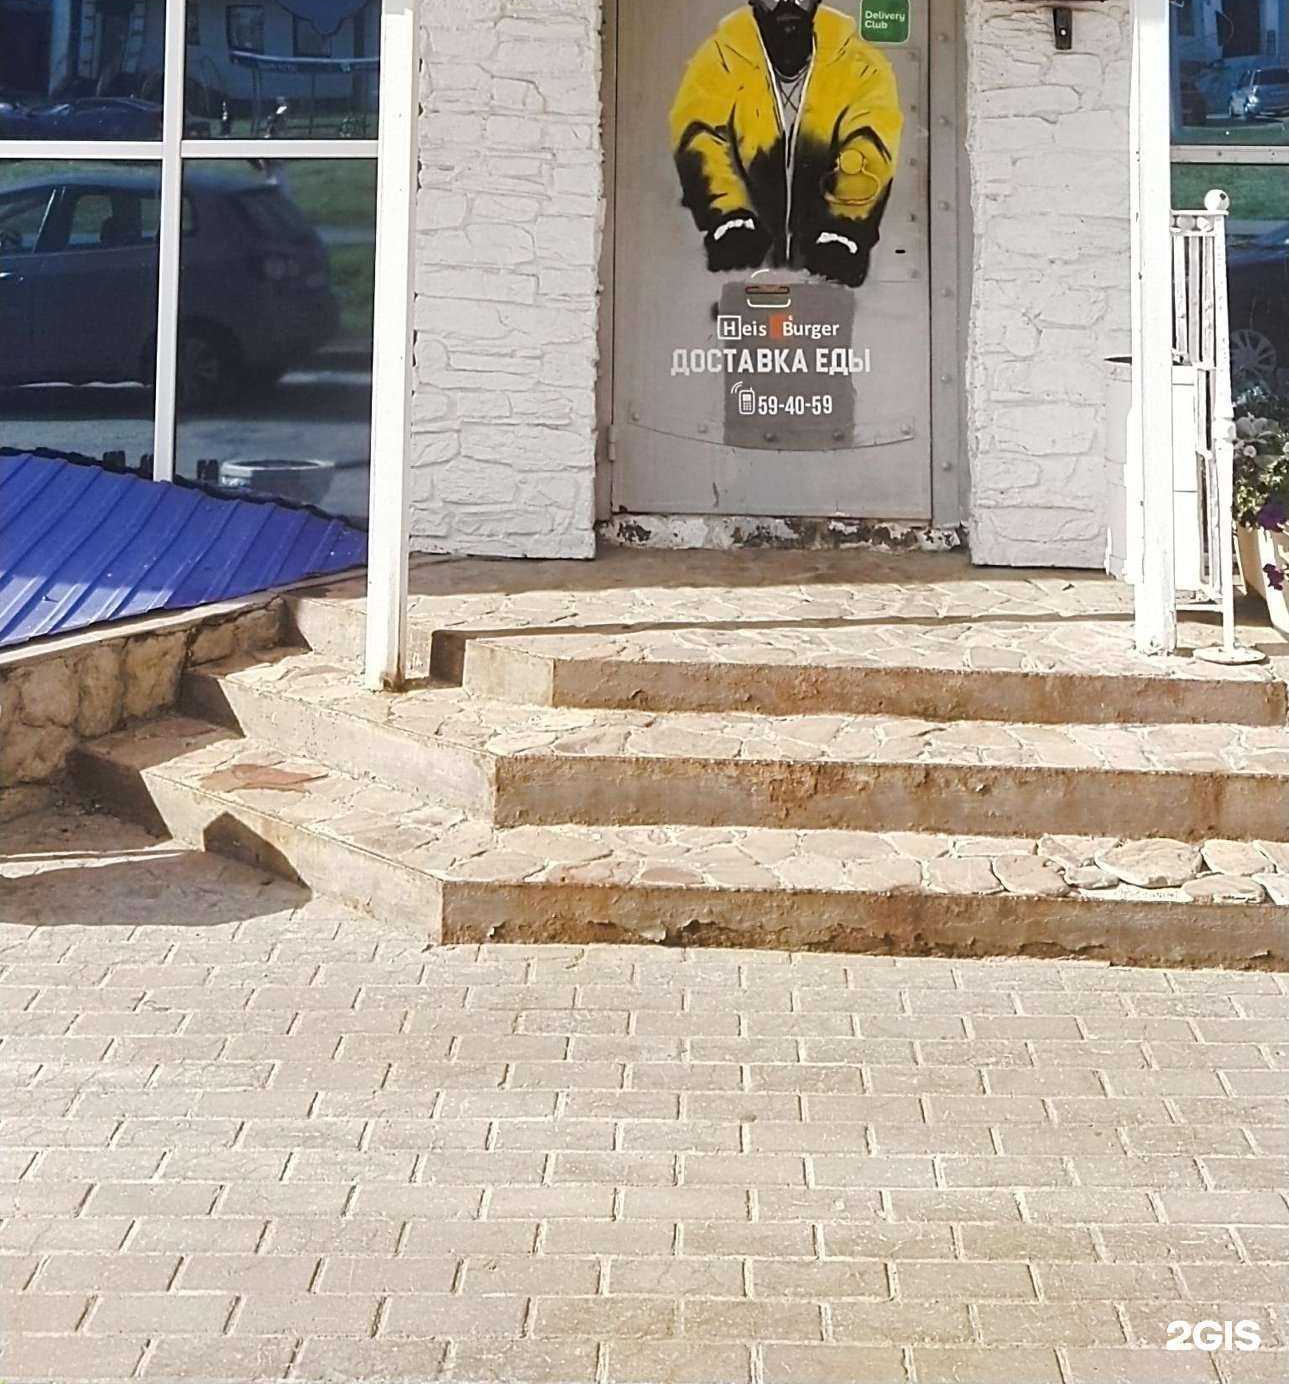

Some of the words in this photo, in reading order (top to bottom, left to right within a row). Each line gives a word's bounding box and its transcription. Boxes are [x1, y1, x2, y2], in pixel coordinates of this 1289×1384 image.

[864, 10, 905, 22] Delivery
[864, 20, 888, 29] Club
[670, 348, 808, 377] ДОСТАВКА
[815, 348, 871, 376] ЕДЫ
[758, 396, 833, 416] 59-40-59
